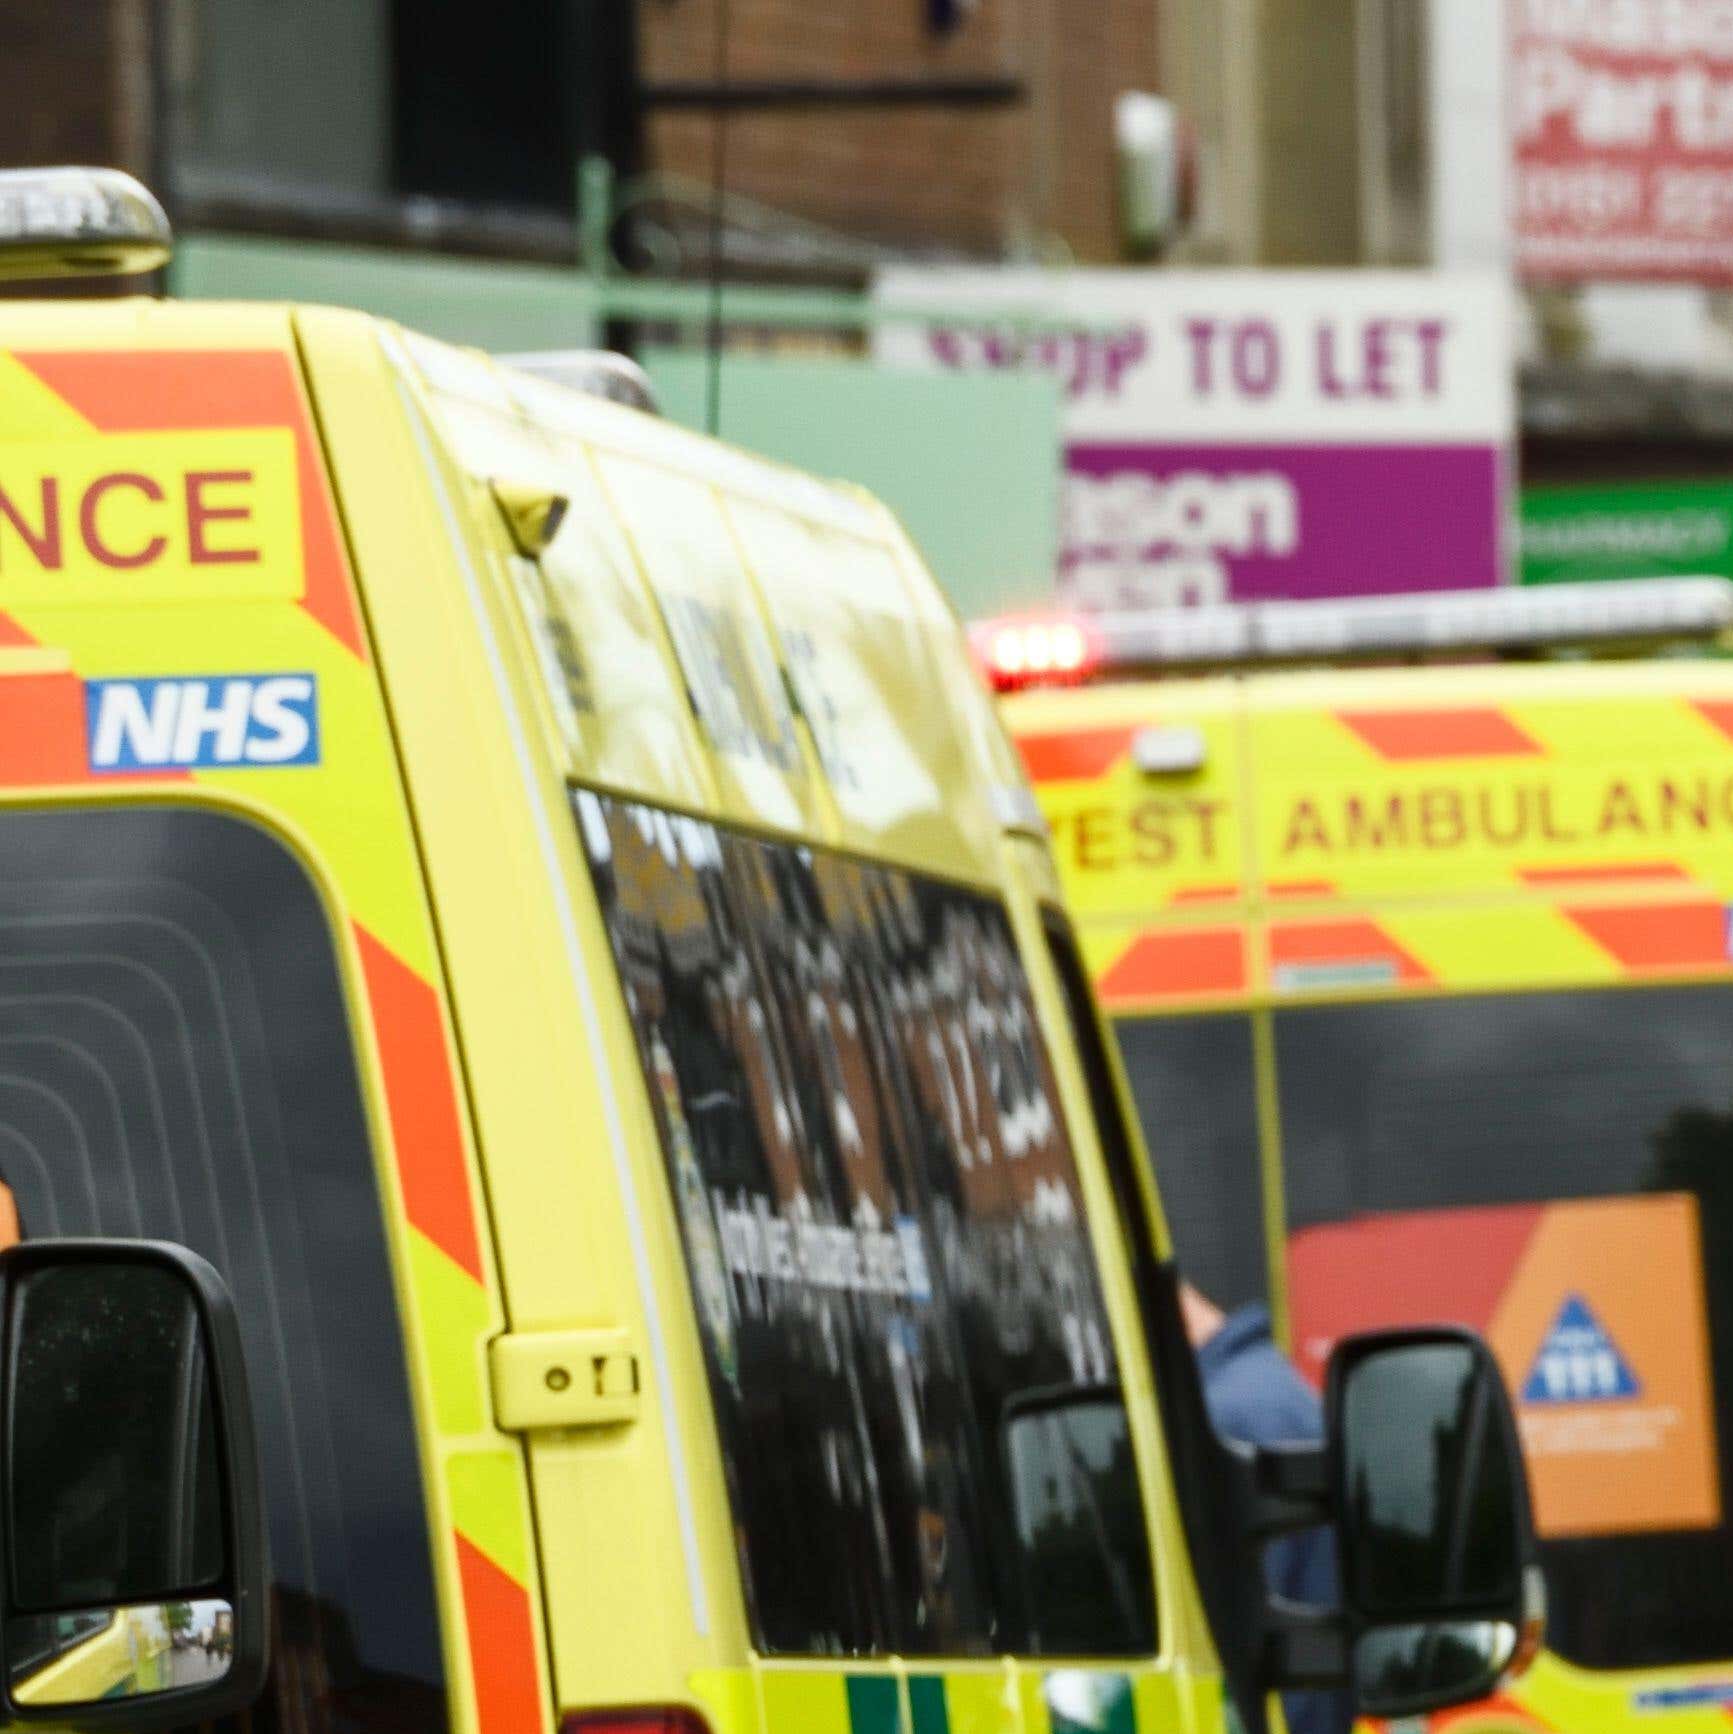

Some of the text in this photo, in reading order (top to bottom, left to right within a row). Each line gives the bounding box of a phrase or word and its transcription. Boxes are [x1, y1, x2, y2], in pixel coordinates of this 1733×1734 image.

[1186, 319, 1283, 399] TO
[1317, 319, 1449, 399] LET
[91, 677, 314, 766] NHS
[1048, 799, 1234, 872] EST
